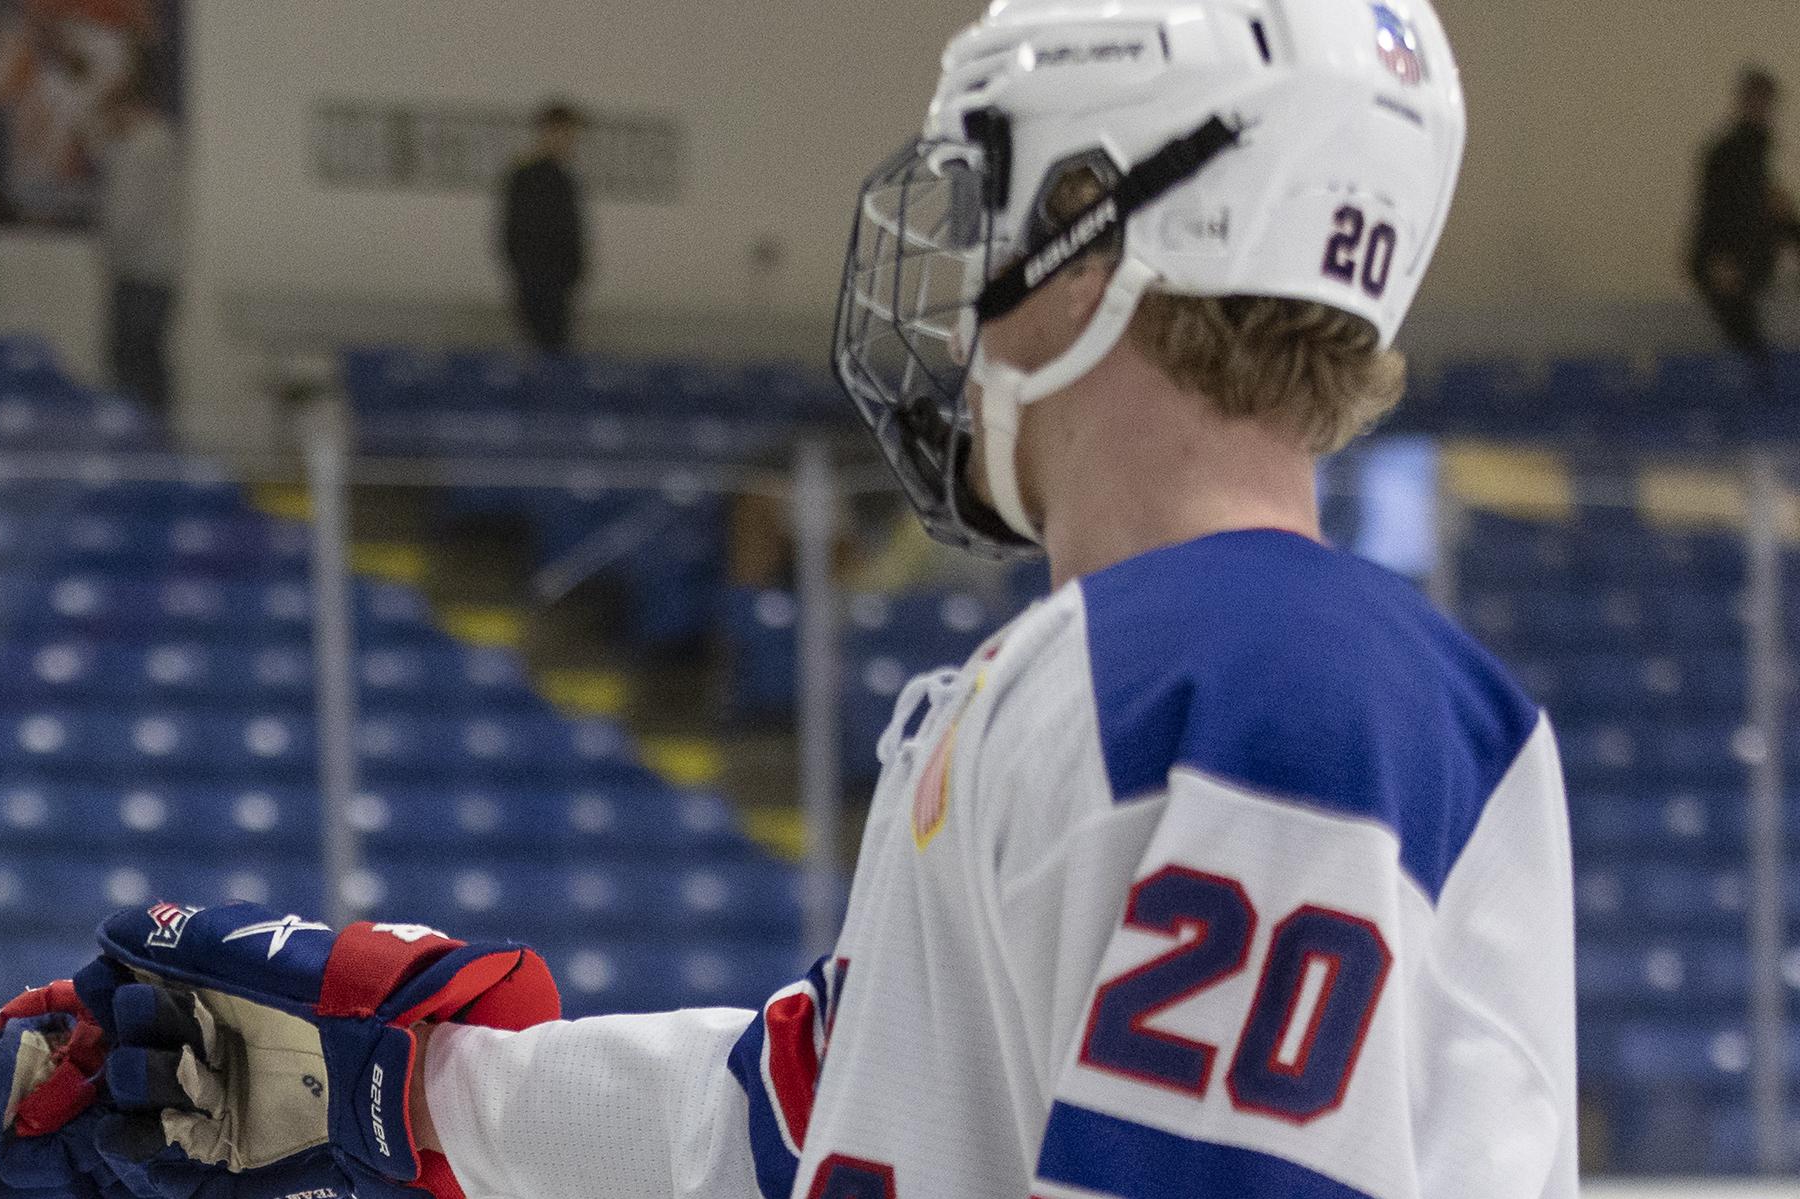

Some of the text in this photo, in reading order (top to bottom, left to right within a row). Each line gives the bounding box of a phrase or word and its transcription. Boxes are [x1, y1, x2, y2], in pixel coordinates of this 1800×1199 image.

[1320, 204, 1397, 301] 20
[1077, 863, 1395, 1127] 20
[369, 1063, 391, 1157] BAUER
